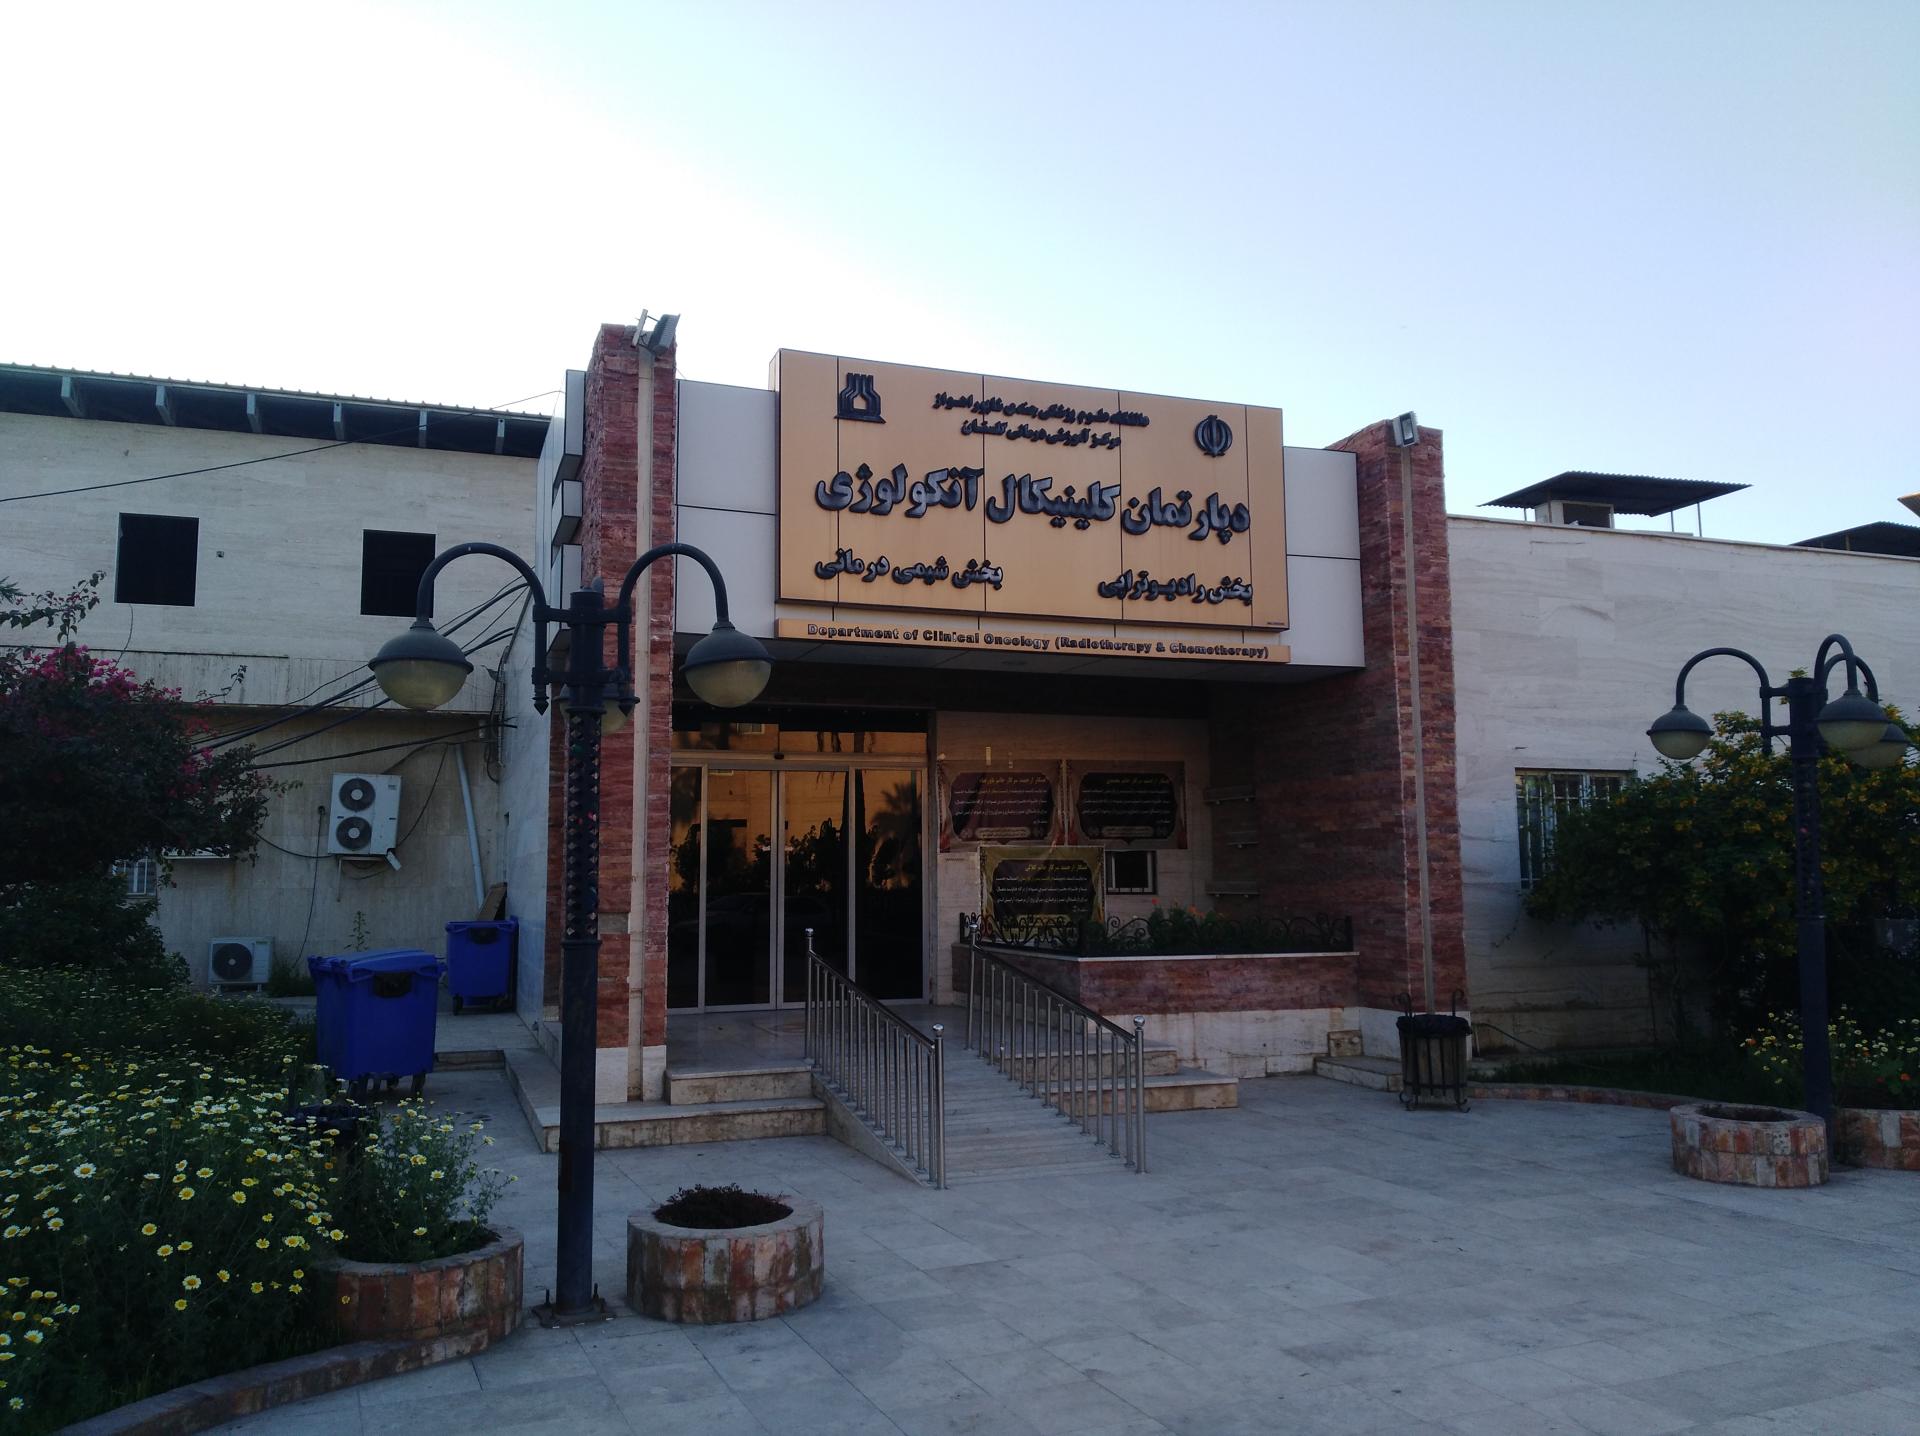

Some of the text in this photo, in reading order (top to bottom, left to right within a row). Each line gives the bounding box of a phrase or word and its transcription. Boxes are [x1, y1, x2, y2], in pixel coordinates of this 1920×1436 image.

[932, 392, 973, 409] اهواز
[1038, 403, 1077, 424] پزشکی
[1077, 408, 1110, 425] علوم
[960, 418, 1122, 450] مرکز آموزشی درمانی گلستان
[815, 462, 1251, 545] دپارتمان کلینیکال آنکولوژی
[815, 547, 1004, 590] بخش شیمی درمانی
[1098, 569, 1253, 606] بخش رادیوتراپی
[807, 623, 1270, 660] Department of Clinical Oncology (Radiotherapy & Chemotherapy)
